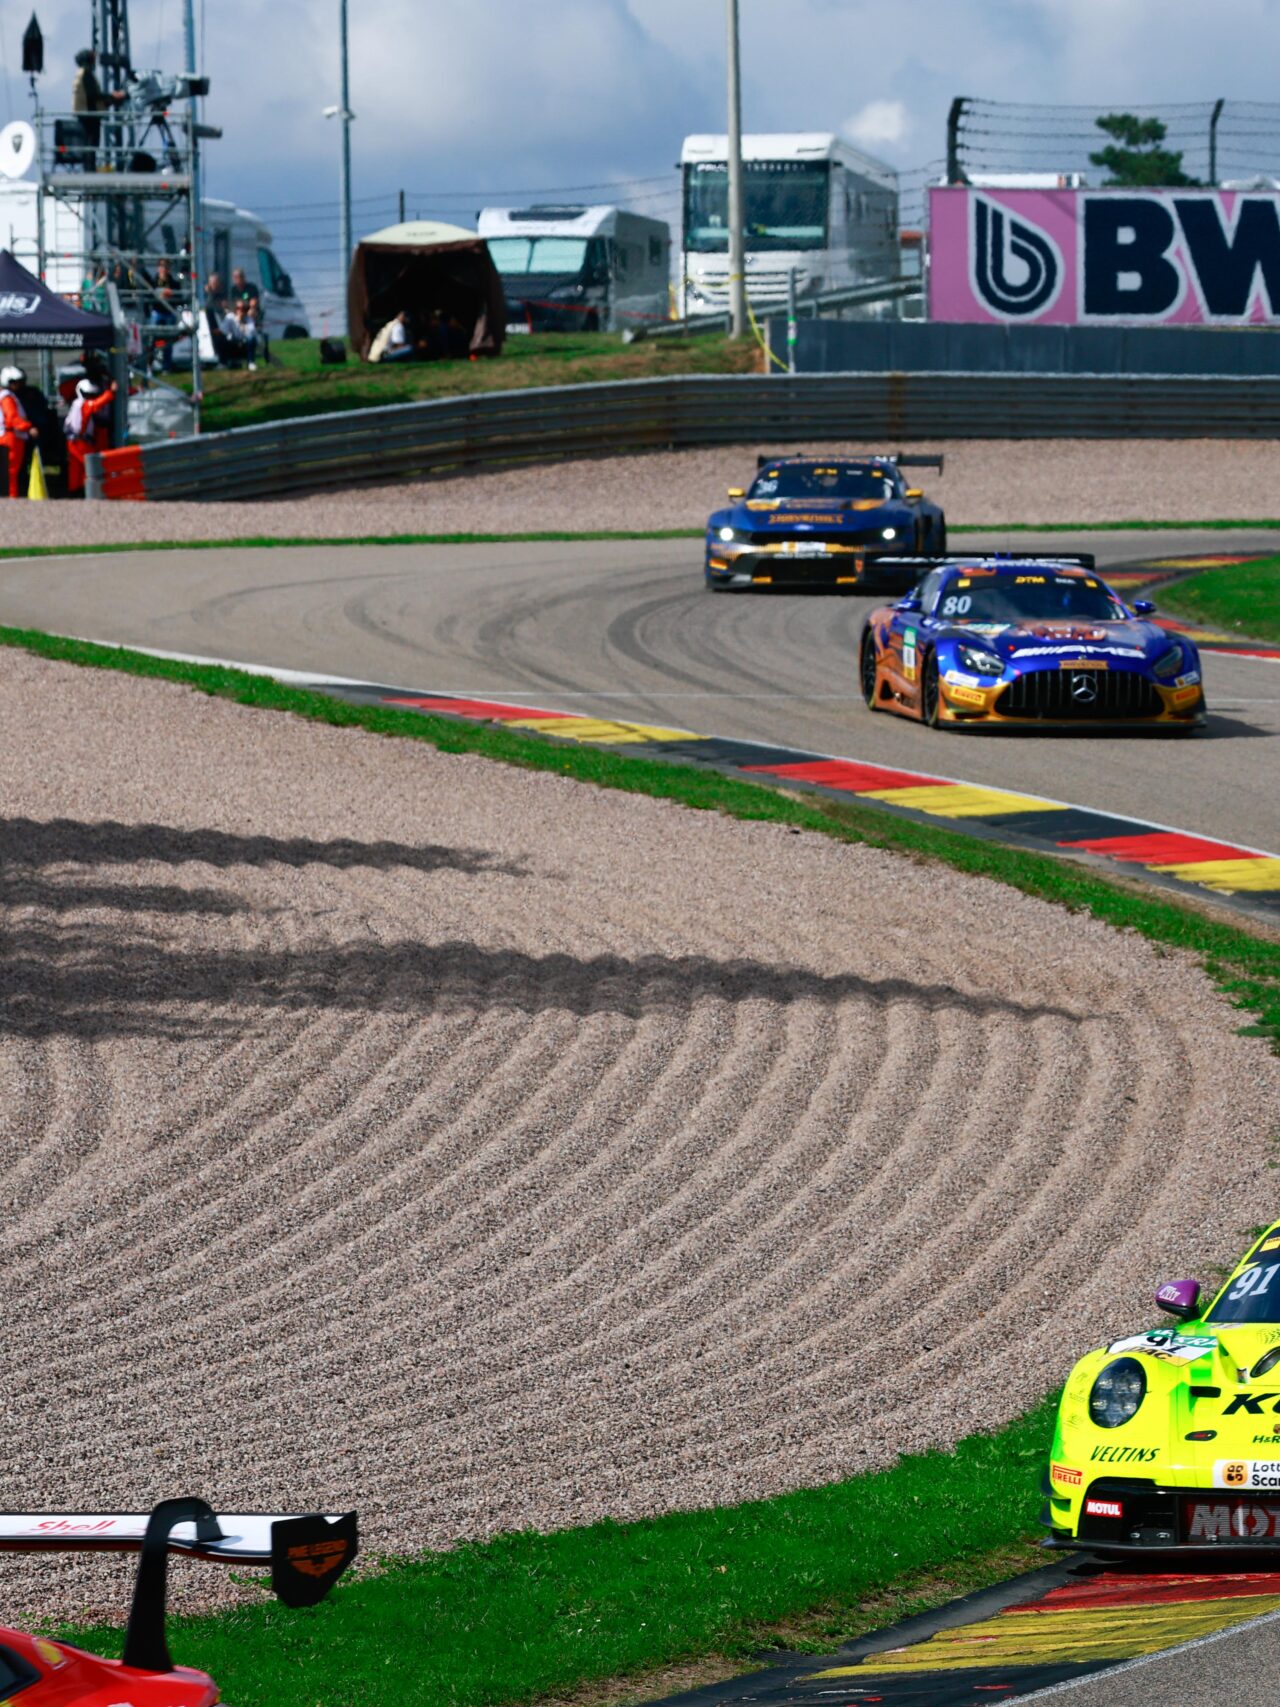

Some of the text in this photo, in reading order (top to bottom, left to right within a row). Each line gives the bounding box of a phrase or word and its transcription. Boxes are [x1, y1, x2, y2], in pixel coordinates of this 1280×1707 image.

[943, 596, 972, 615] 80
[1089, 1445, 1161, 1463] VELTINS
[1052, 1464, 1083, 1486] PIRELLI
[1086, 1501, 1121, 1516] MOTUL
[30, 1520, 117, 1532] Shell
